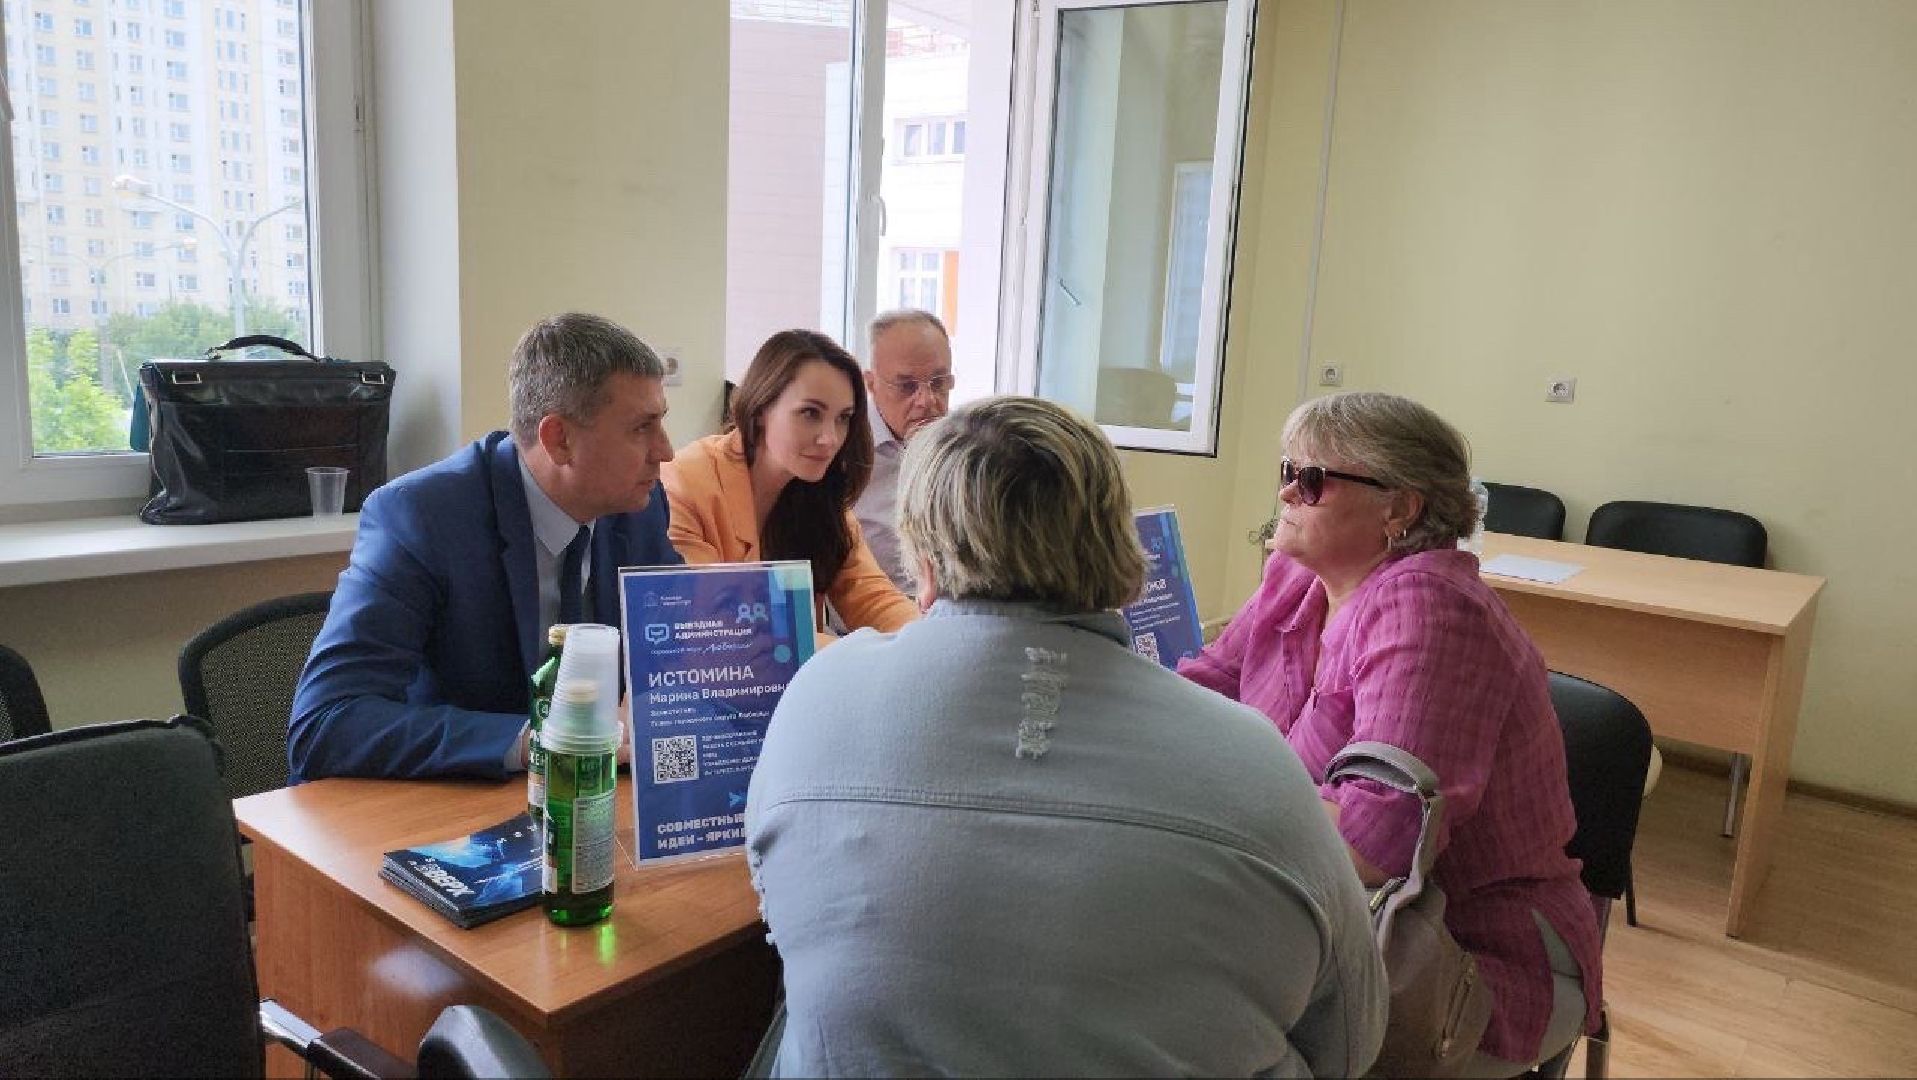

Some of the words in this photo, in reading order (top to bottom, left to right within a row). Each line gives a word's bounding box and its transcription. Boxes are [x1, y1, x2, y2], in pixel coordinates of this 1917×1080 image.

[674, 628, 753, 640] АДМИНИСТРАЦИЯ
[648, 665, 754, 688] ИСТОМИНА
[649, 690, 699, 705] Марина
[657, 835, 695, 850] ИДЕИ
